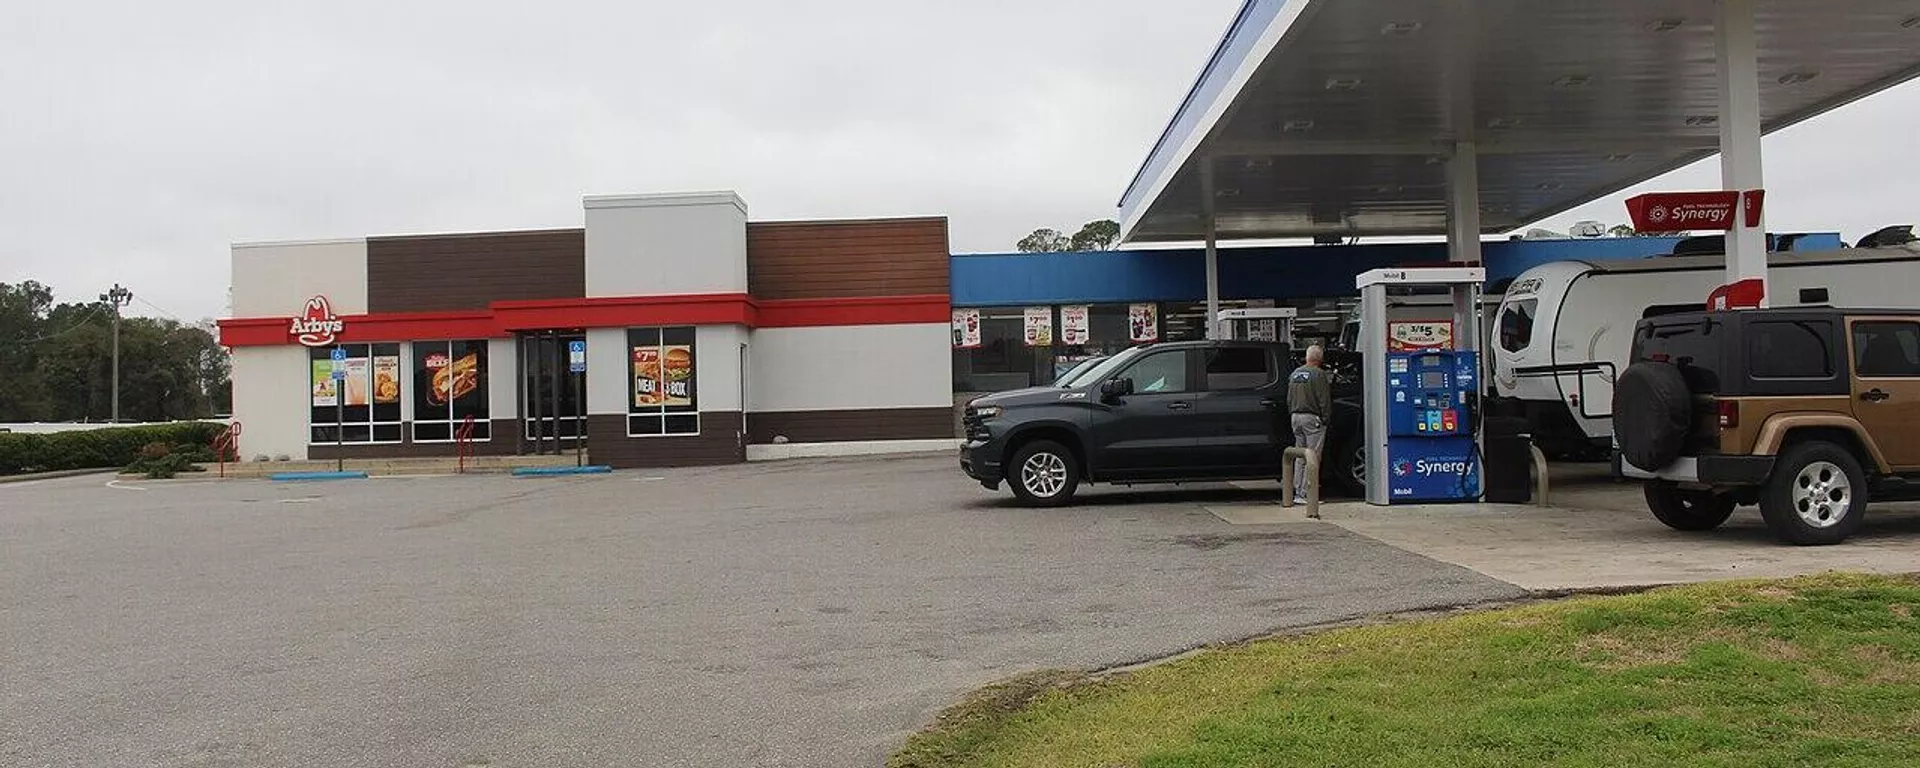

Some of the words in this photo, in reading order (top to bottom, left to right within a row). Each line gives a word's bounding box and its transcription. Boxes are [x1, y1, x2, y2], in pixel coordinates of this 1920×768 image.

[1672, 207, 1729, 222] Synergy
[1401, 271, 1406, 280] 8
[290, 315, 343, 336] Arby's
[671, 382, 686, 396] BOX
[1416, 460, 1474, 477] Synergy
[1394, 487, 1412, 495] Mobil
